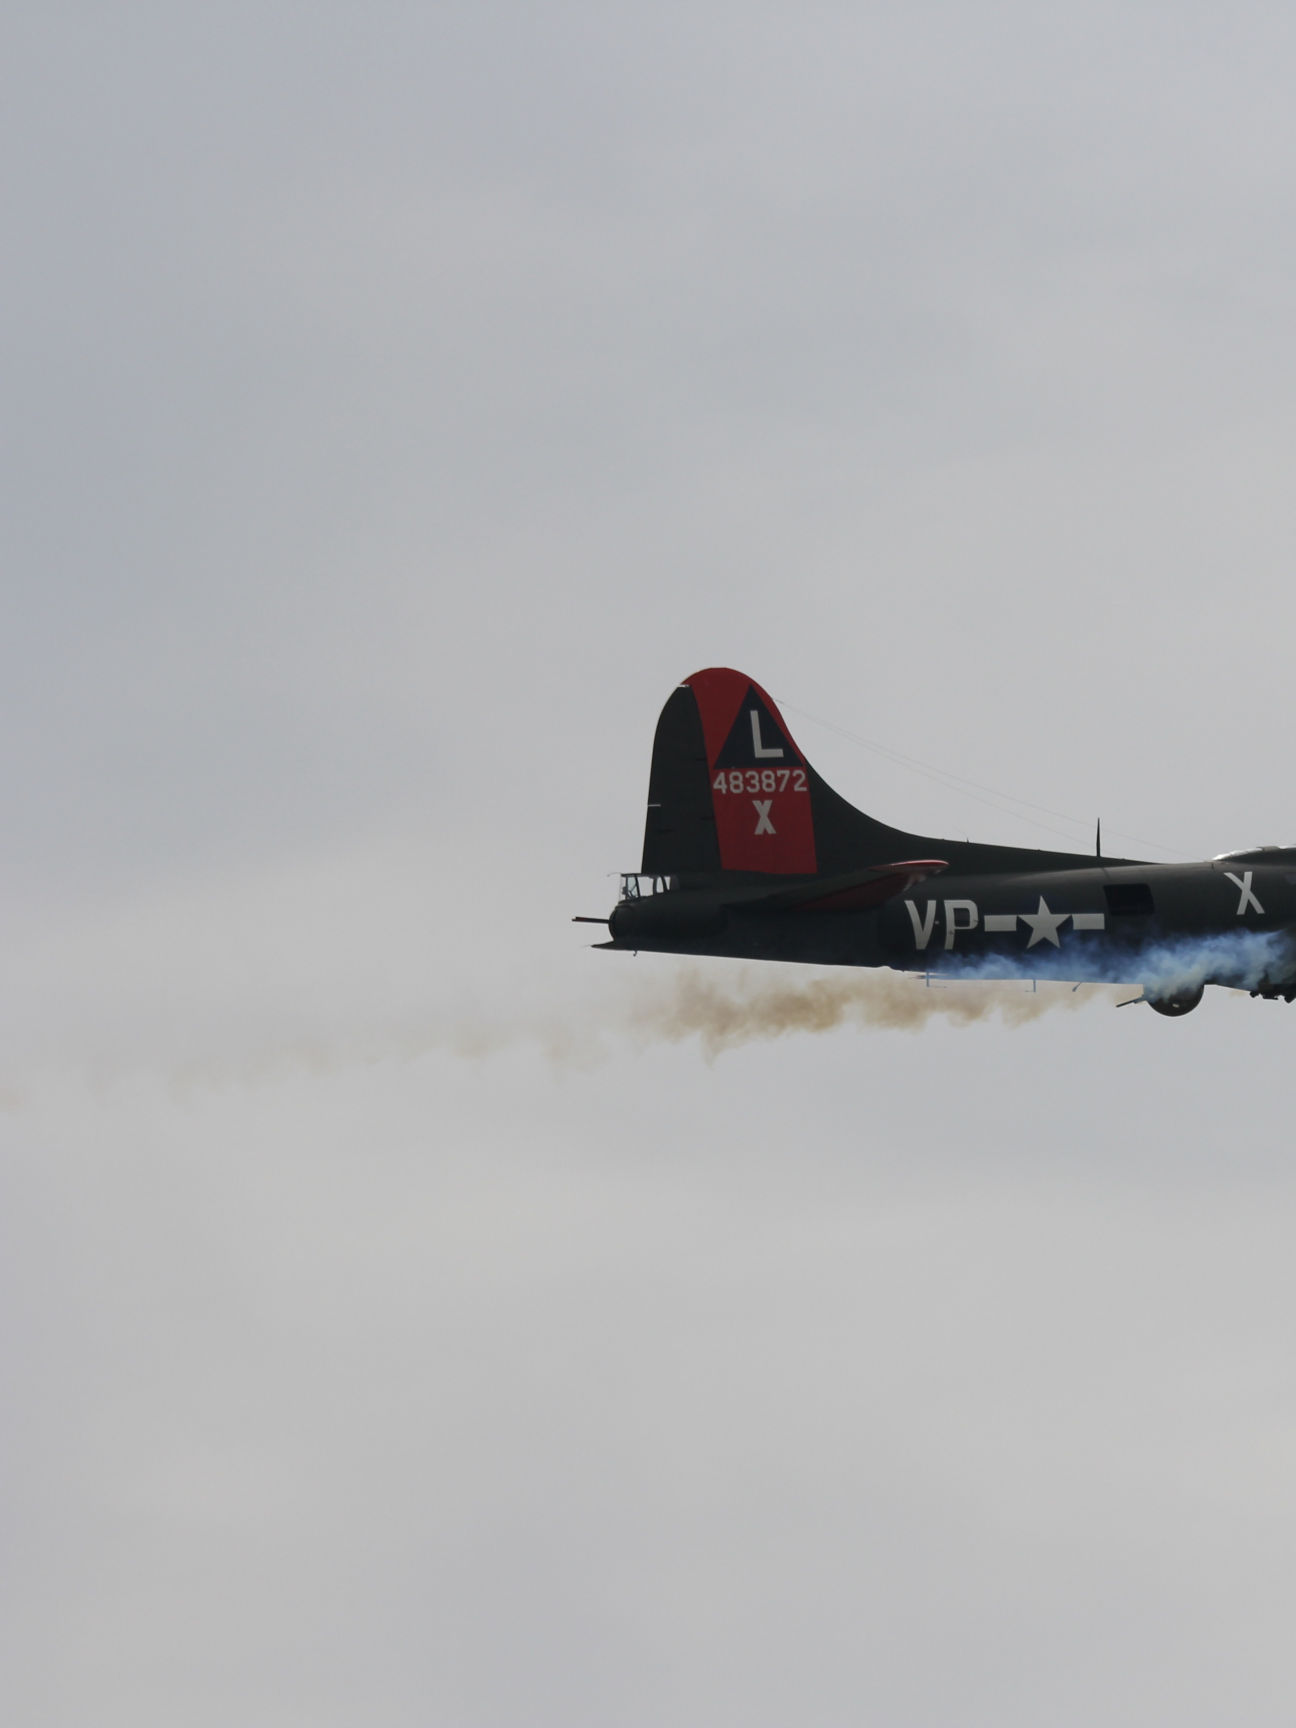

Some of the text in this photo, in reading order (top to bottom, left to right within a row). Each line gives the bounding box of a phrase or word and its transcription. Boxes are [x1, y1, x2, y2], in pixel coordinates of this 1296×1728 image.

[750, 710, 784, 758] L
[713, 769, 808, 794] 483872
[752, 800, 777, 835] X
[1223, 871, 1265, 915] X
[903, 898, 979, 951] VP
